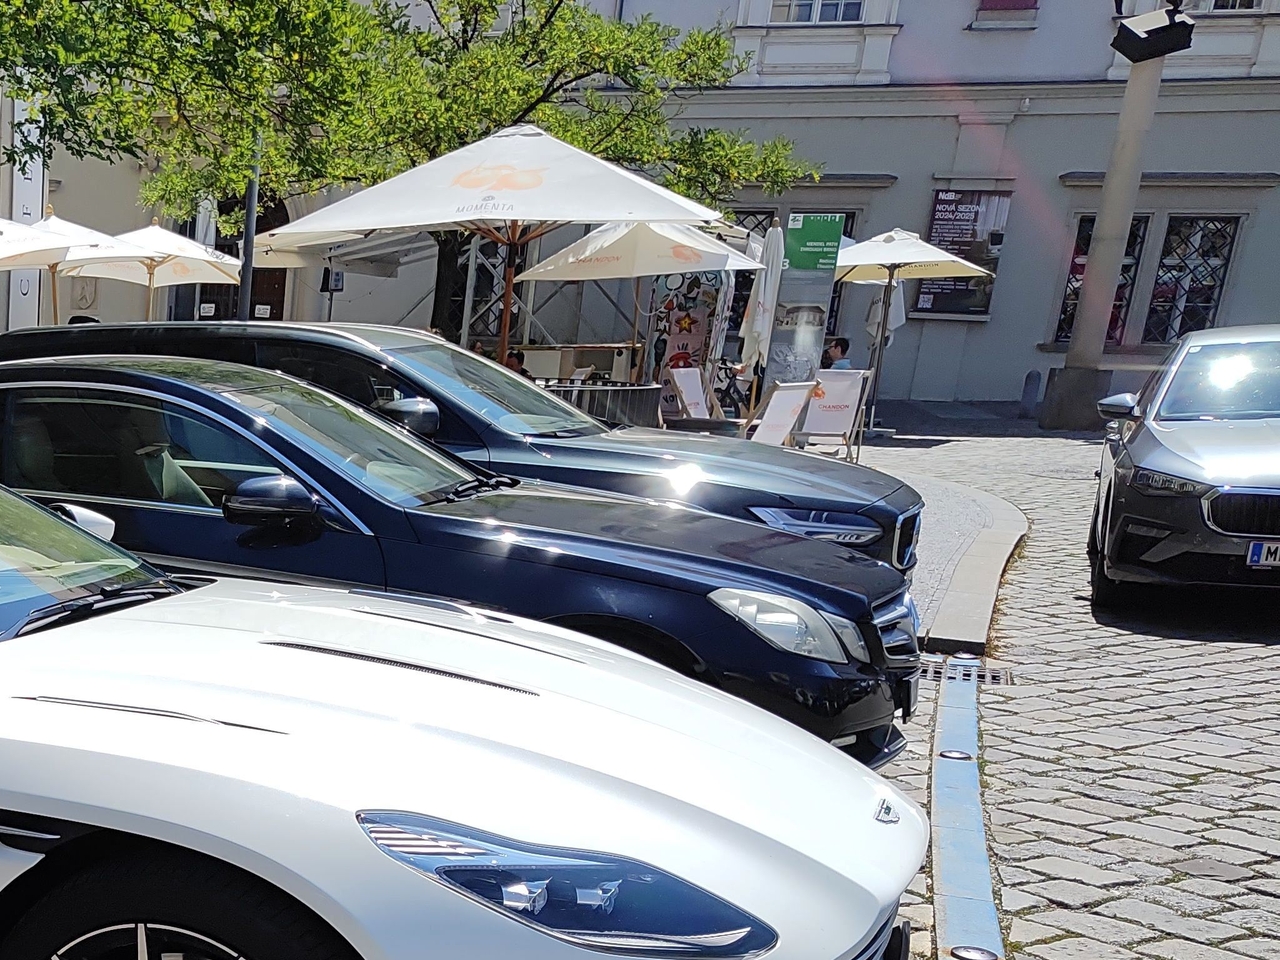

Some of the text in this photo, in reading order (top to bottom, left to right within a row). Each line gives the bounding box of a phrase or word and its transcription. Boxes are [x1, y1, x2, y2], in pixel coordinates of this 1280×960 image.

[938, 191, 955, 200] NdB
[455, 203, 514, 214] MOMENTA
[935, 203, 986, 212] NOVÁ SEZONA
[934, 212, 975, 220] 2024/2025
[1265, 545, 1280, 562] M
